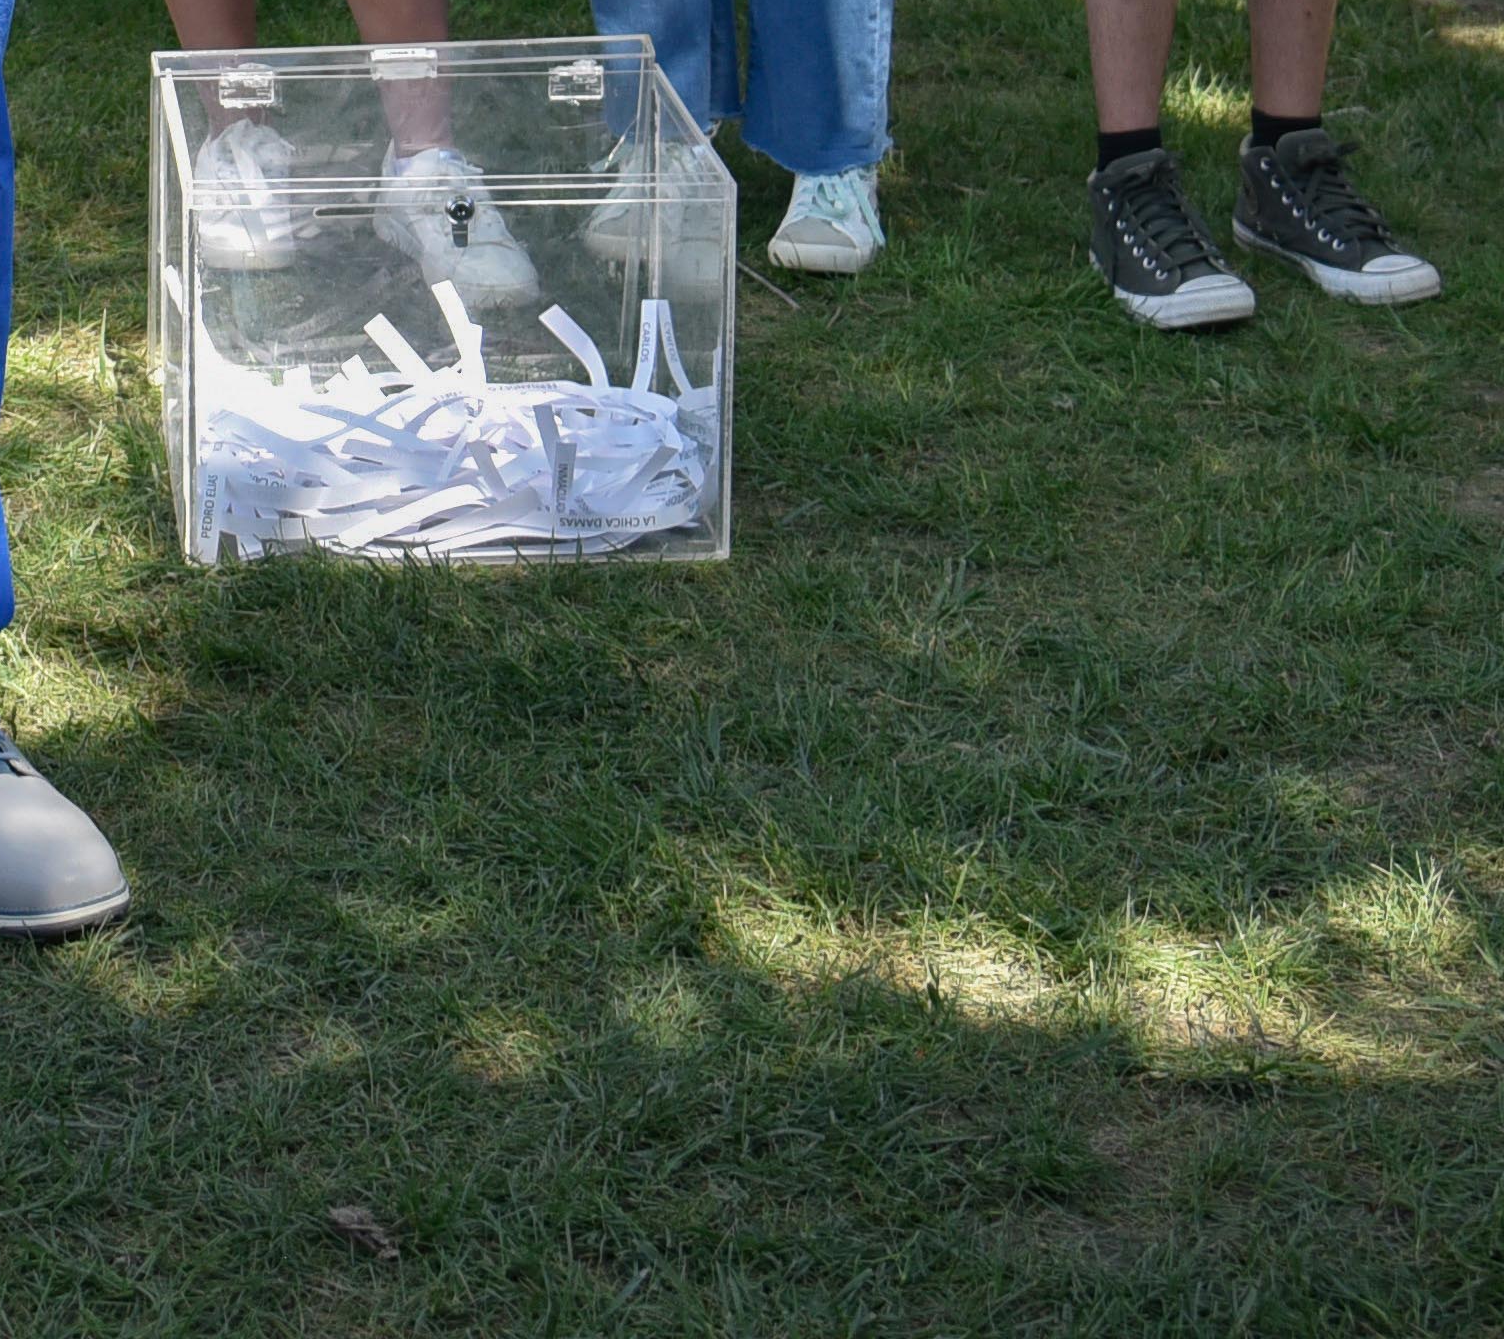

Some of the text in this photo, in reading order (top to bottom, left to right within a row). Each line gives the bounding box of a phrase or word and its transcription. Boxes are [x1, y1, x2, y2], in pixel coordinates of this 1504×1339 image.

[640, 322, 652, 364] CARLOS
[200, 474, 219, 540] PEDRO ELIAS
[559, 515, 657, 530] LA CHICA DAMAS
